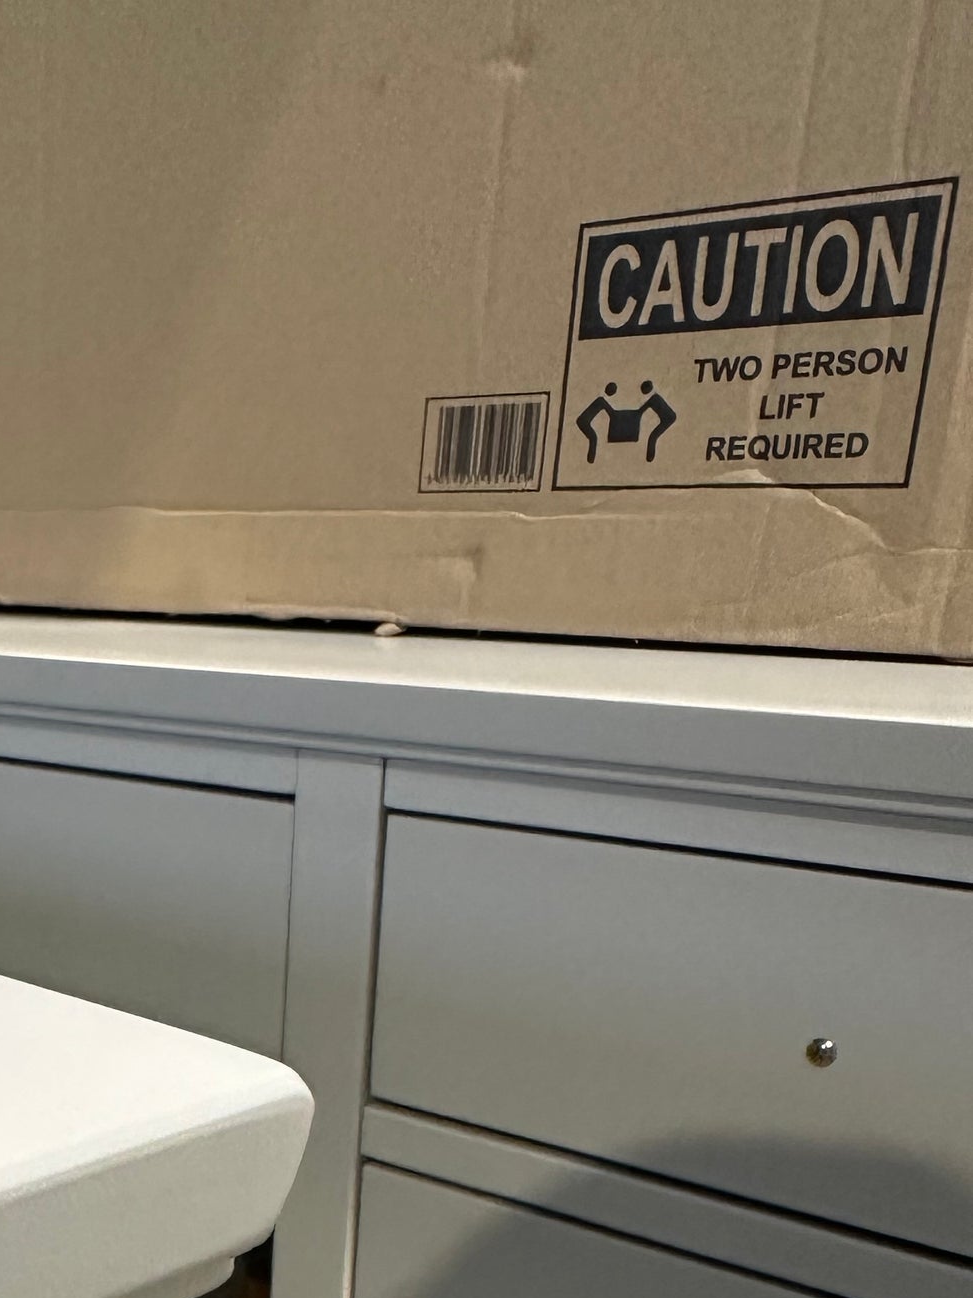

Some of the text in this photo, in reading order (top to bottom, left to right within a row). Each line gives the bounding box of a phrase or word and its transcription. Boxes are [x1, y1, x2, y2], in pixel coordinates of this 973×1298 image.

[598, 212, 919, 329] CAUTION
[694, 346, 909, 382] TWO PERSON
[759, 392, 826, 420] LIFT
[704, 431, 870, 461] REQUIRED
